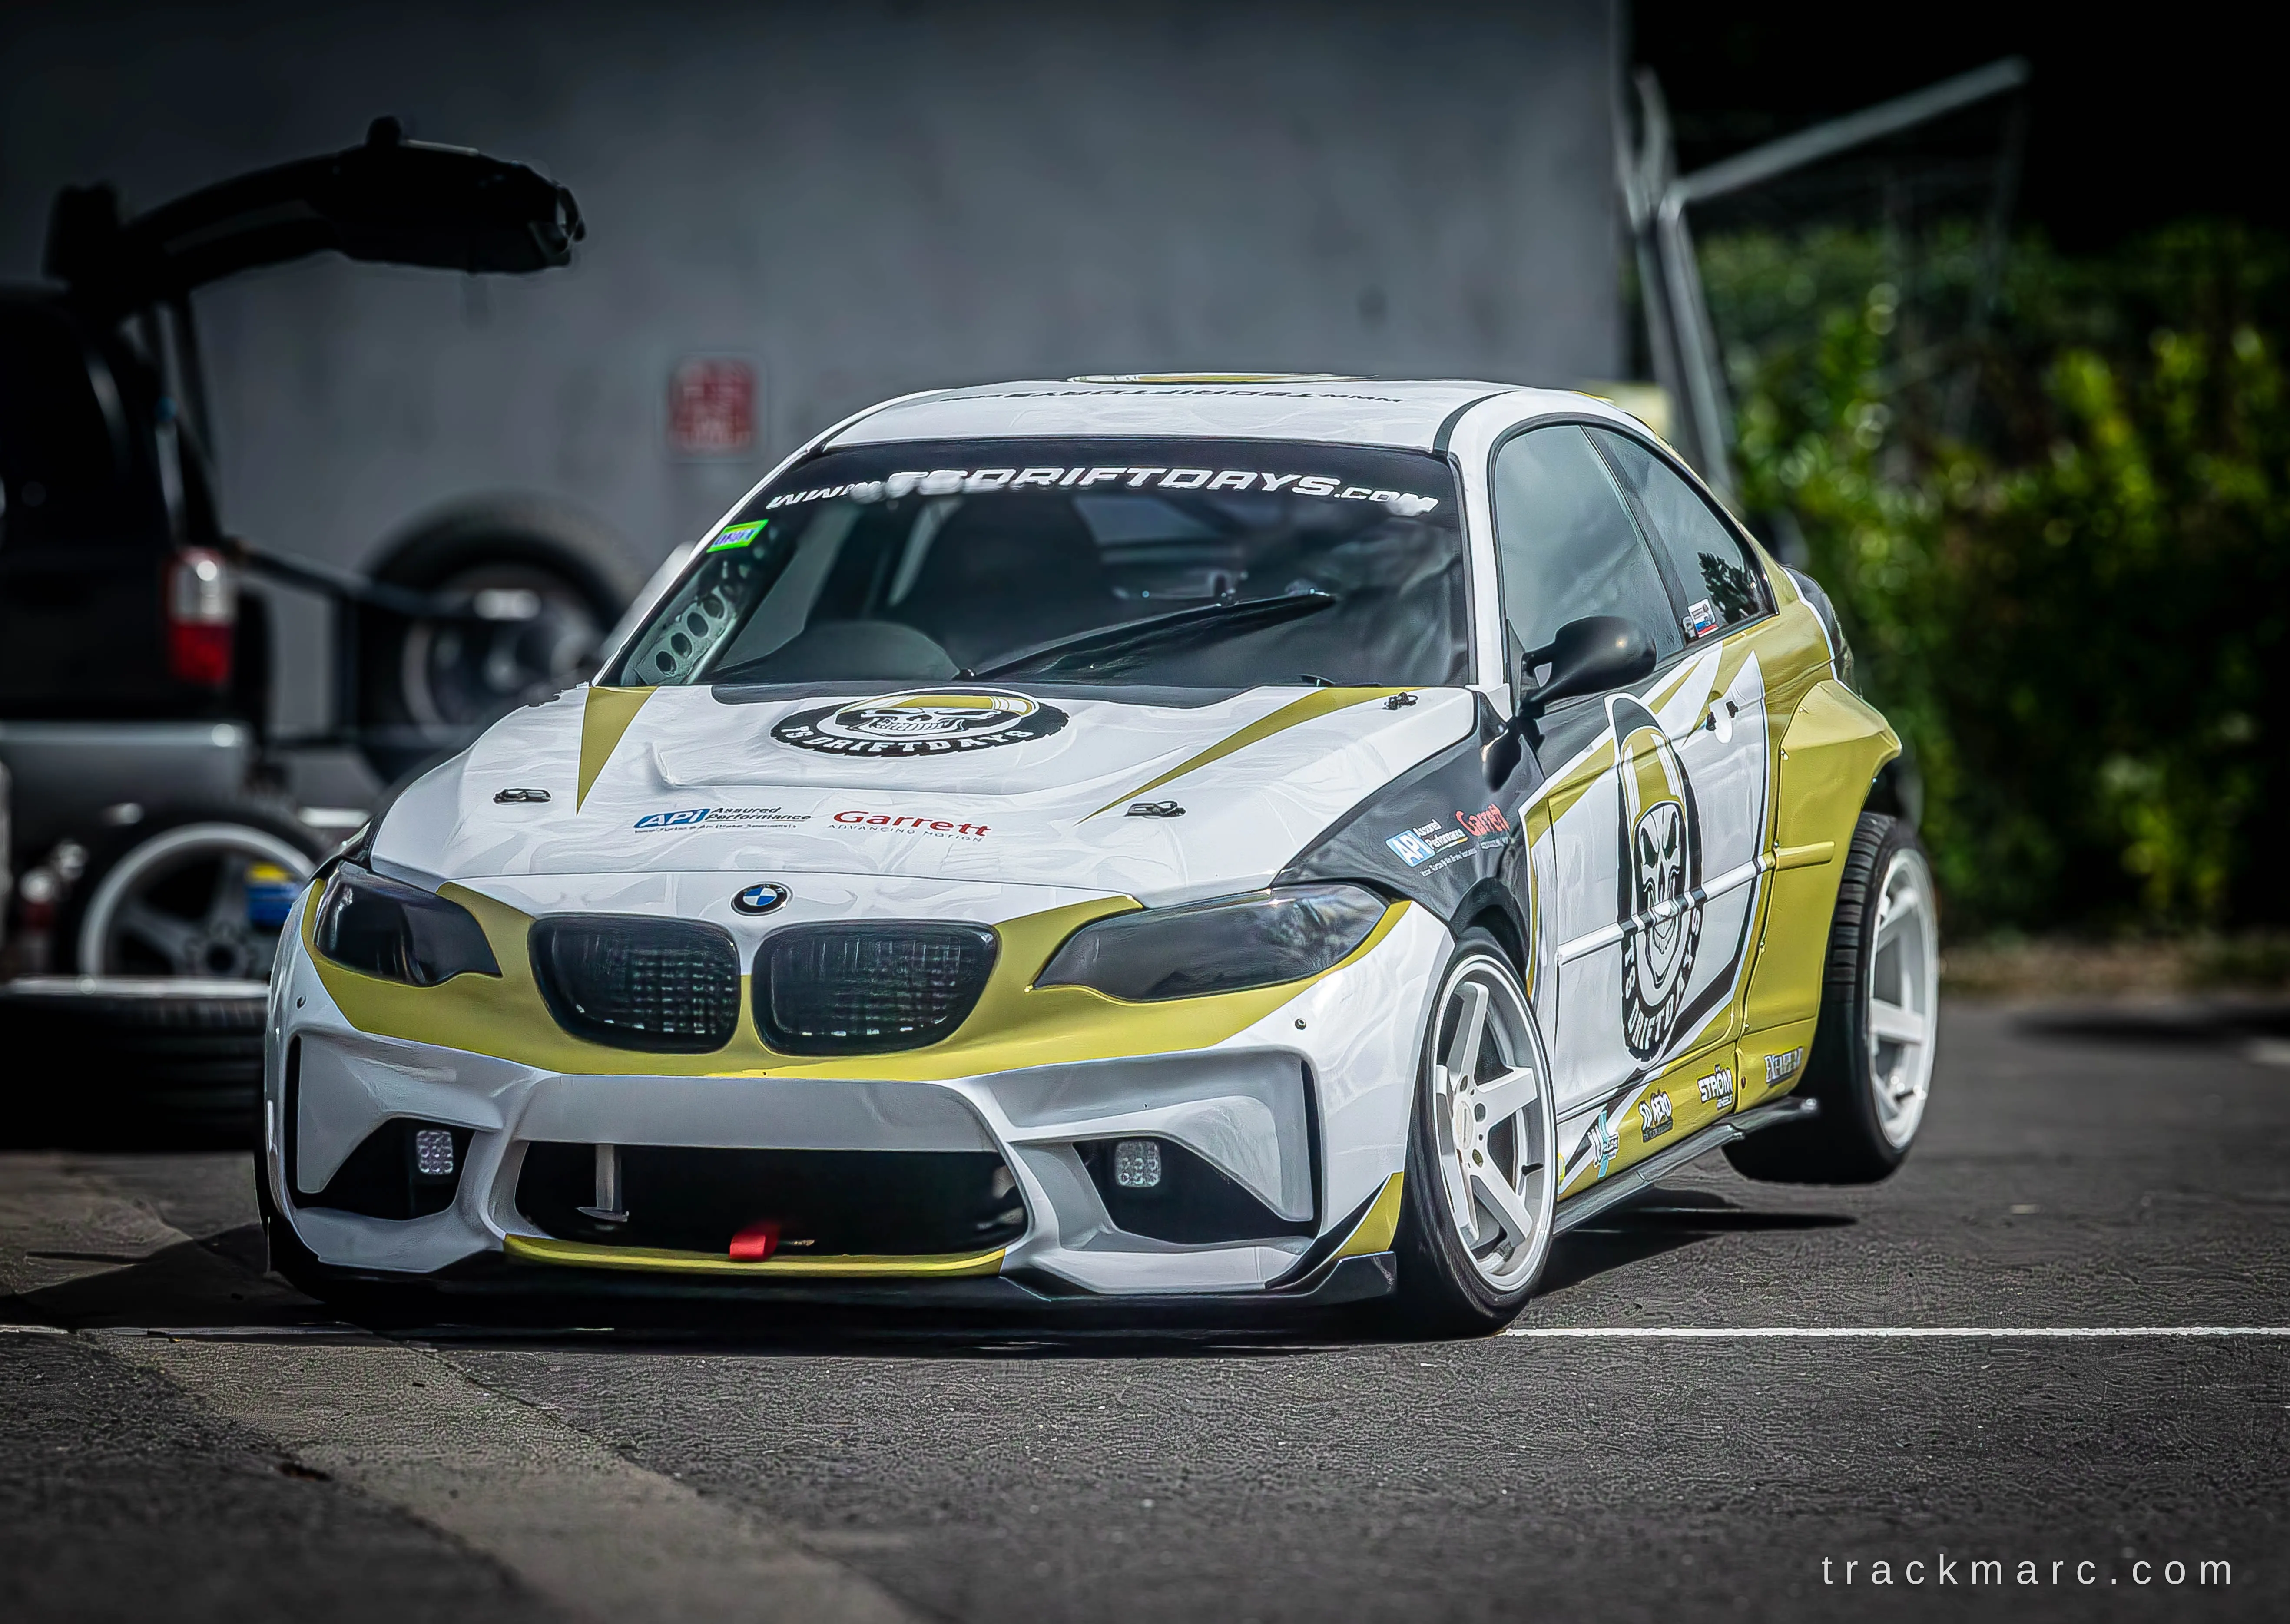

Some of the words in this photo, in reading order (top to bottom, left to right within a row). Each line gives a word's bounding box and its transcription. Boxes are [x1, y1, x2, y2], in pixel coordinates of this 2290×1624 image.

[639, 809, 706, 827] API
[833, 811, 991, 837] Garrett
[828, 824, 915, 834] ADVANCING
[923, 831, 983, 842] MOTION
[1391, 832, 1434, 865] API
